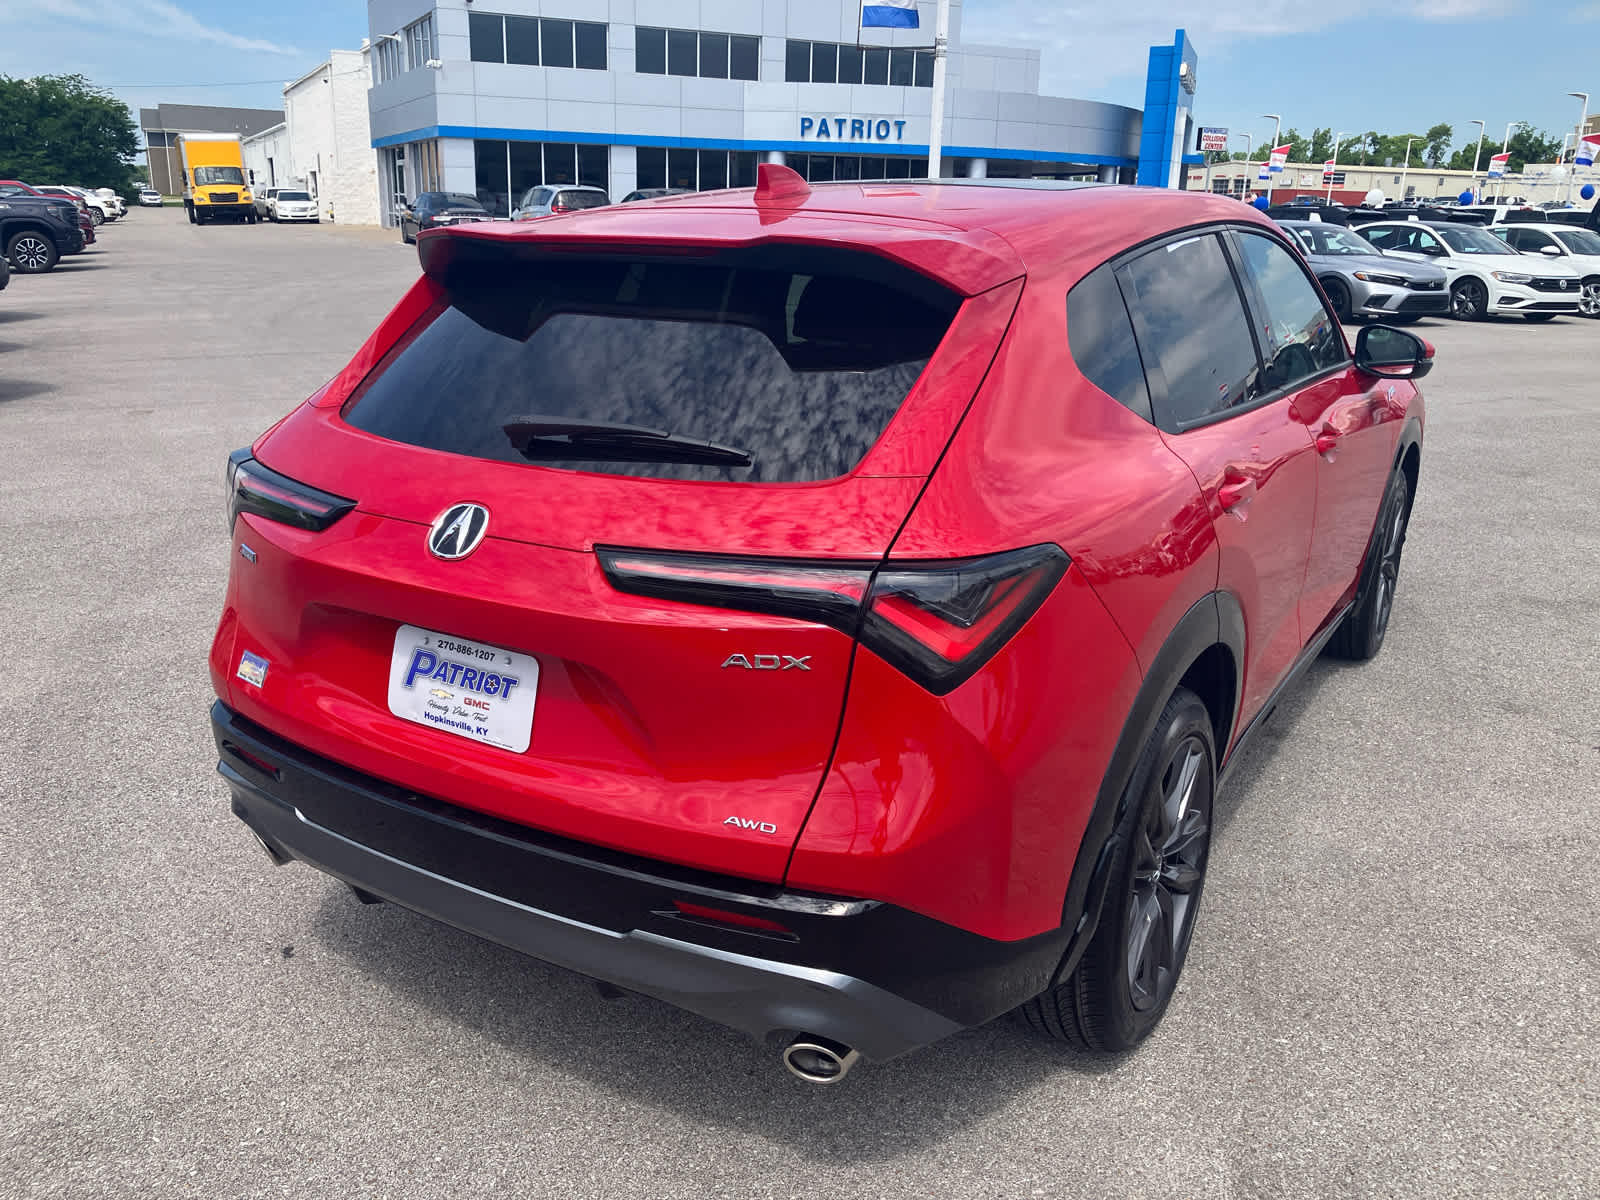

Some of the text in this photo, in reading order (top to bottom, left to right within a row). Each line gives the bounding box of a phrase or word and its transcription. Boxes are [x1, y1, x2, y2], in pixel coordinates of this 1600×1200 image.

[800, 117, 906, 140] PATRIOT
[437, 639, 496, 662] 270-886-1207
[721, 653, 812, 671] ADX
[403, 648, 518, 699] PATRIOT
[463, 696, 490, 711] GMC
[424, 711, 489, 736] Hopkinsville, KY
[723, 815, 777, 835] AWD
